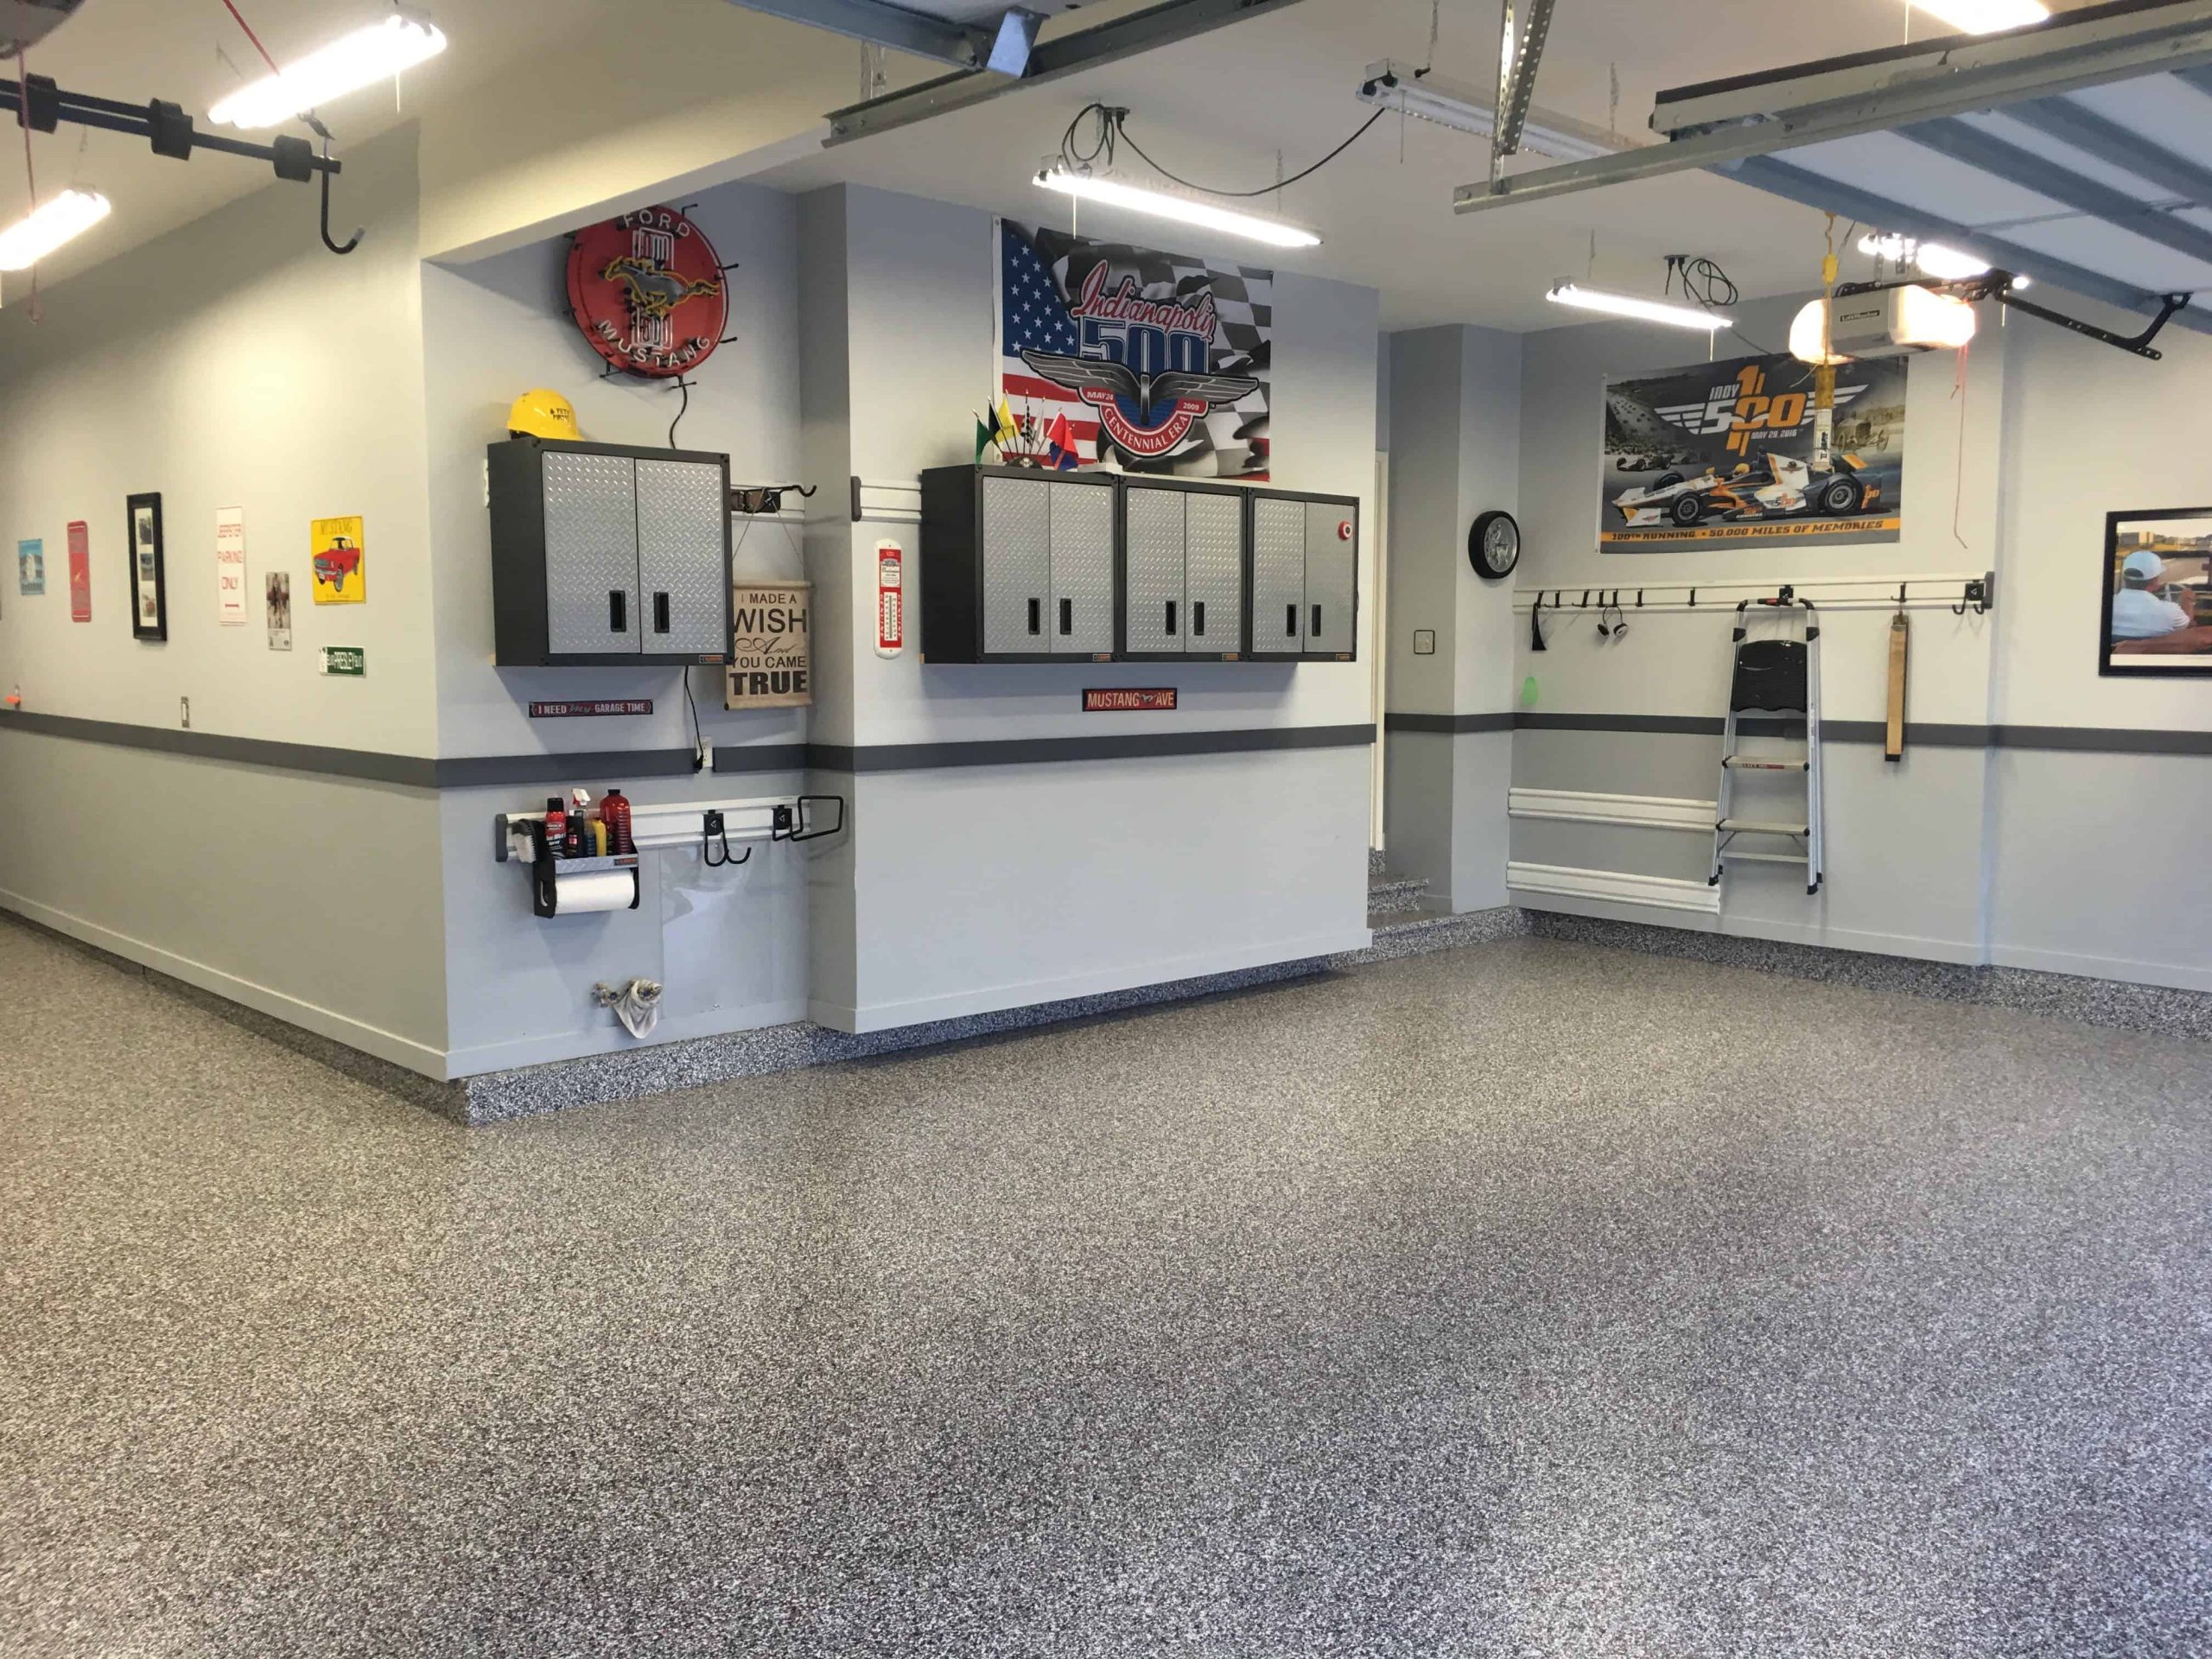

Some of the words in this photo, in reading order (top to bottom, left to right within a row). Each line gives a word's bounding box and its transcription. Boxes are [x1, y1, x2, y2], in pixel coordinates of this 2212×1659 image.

[623, 210, 690, 237] FORD
[598, 319, 710, 367] MUSTANG
[1081, 316, 1209, 375] 500
[1709, 384, 1739, 400] INDY
[1182, 402, 1200, 410] 2009
[1103, 408, 1168, 449] CENTENNIAL
[1167, 415, 1188, 439] ERA
[1779, 429, 1797, 438] 2016
[1643, 531, 1695, 540] RUNNING
[1751, 525, 1790, 535] MILES
[1794, 524, 1809, 533] OF
[1812, 519, 1884, 532] MEMORIES
[221, 576, 239, 589] ONLY
[749, 594, 786, 604] MADE
[789, 594, 797, 604] A
[734, 608, 807, 633] WISH
[732, 656, 760, 669] YOU
[765, 656, 807, 669] CAME
[728, 671, 808, 696] TRUE
[1088, 692, 1140, 707] MUSTANG
[1155, 692, 1174, 706] AVE
[538, 705, 542, 714] I
[543, 704, 567, 714] NEED
[594, 702, 625, 713] GARAGE
[627, 702, 645, 712] TIME
